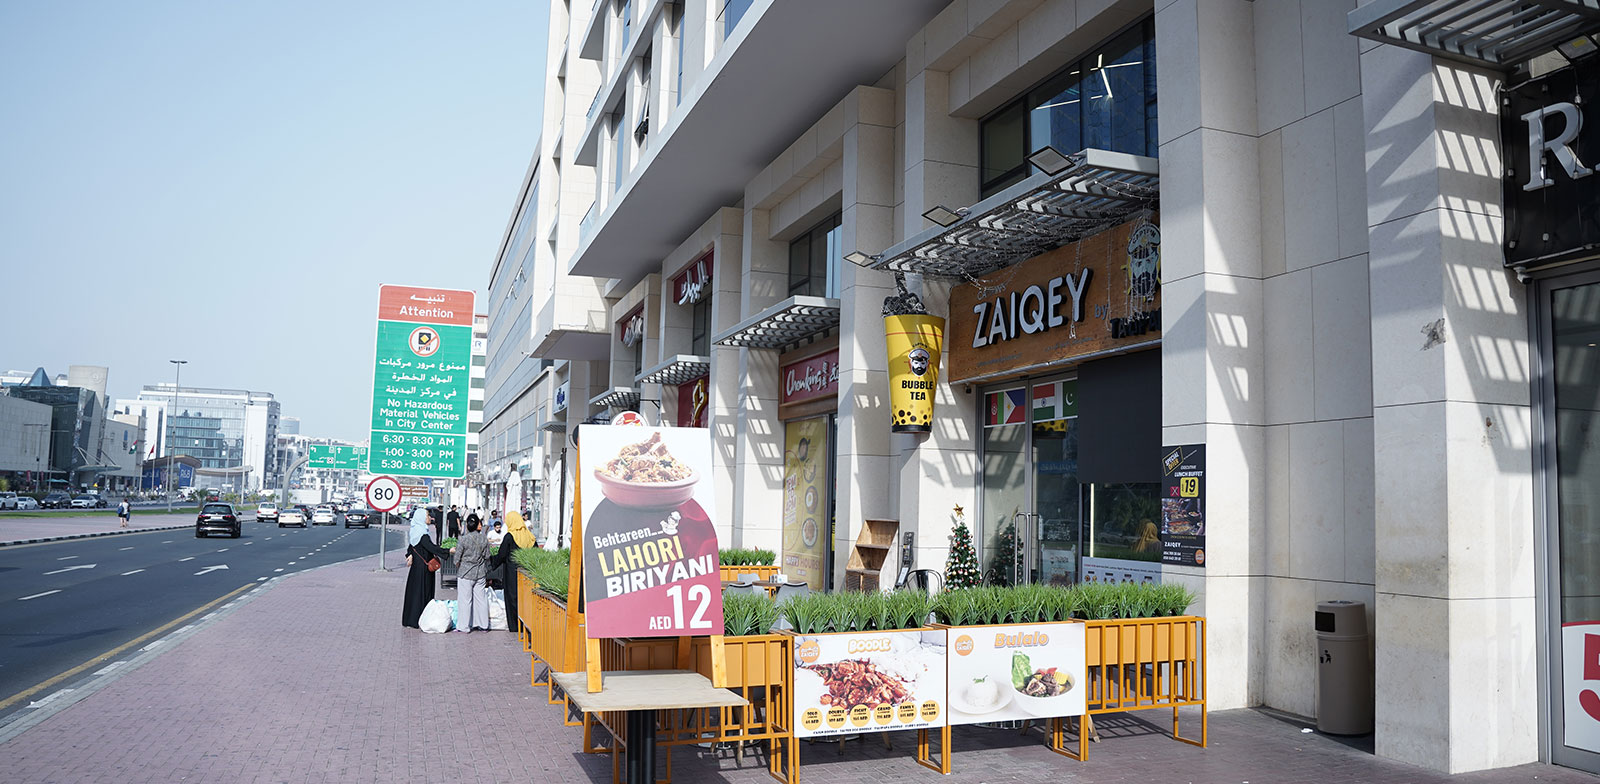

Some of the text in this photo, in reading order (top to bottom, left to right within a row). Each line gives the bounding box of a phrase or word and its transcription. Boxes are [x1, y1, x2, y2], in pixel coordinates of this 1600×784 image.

[399, 305, 454, 319] Attention
[972, 267, 1090, 348] ZAIQEY
[1095, 304, 1108, 320] by
[379, 358, 466, 371] ممنوع مرور مركبات
[392, 372, 453, 384] المواد الخطرة
[901, 380, 934, 390] BUBBLE
[385, 385, 457, 400] في مركز المدينة
[910, 391, 926, 400] TEA
[387, 398, 453, 411] No Hazardous
[379, 408, 460, 421] Material Vehicles
[385, 418, 454, 430] In City Center
[382, 434, 405, 444] 6:30
[412, 435, 434, 446] 8:30
[438, 437, 455, 446] AM
[384, 447, 404, 457] 1:00
[411, 449, 433, 458] 3:00
[439, 450, 454, 459] PM
[1165, 451, 1180, 467] SPECIAL
[381, 459, 403, 469] 5:30
[410, 461, 432, 470] 8:00
[438, 463, 454, 471] PM
[1185, 479, 1196, 493] 19
[374, 487, 394, 501] 80
[598, 535, 684, 577] LAHORI
[606, 554, 714, 598] BIRIYANI
[649, 584, 712, 630] AED 12
[848, 638, 891, 654] BOODLE
[994, 631, 1049, 648] Bulalo
